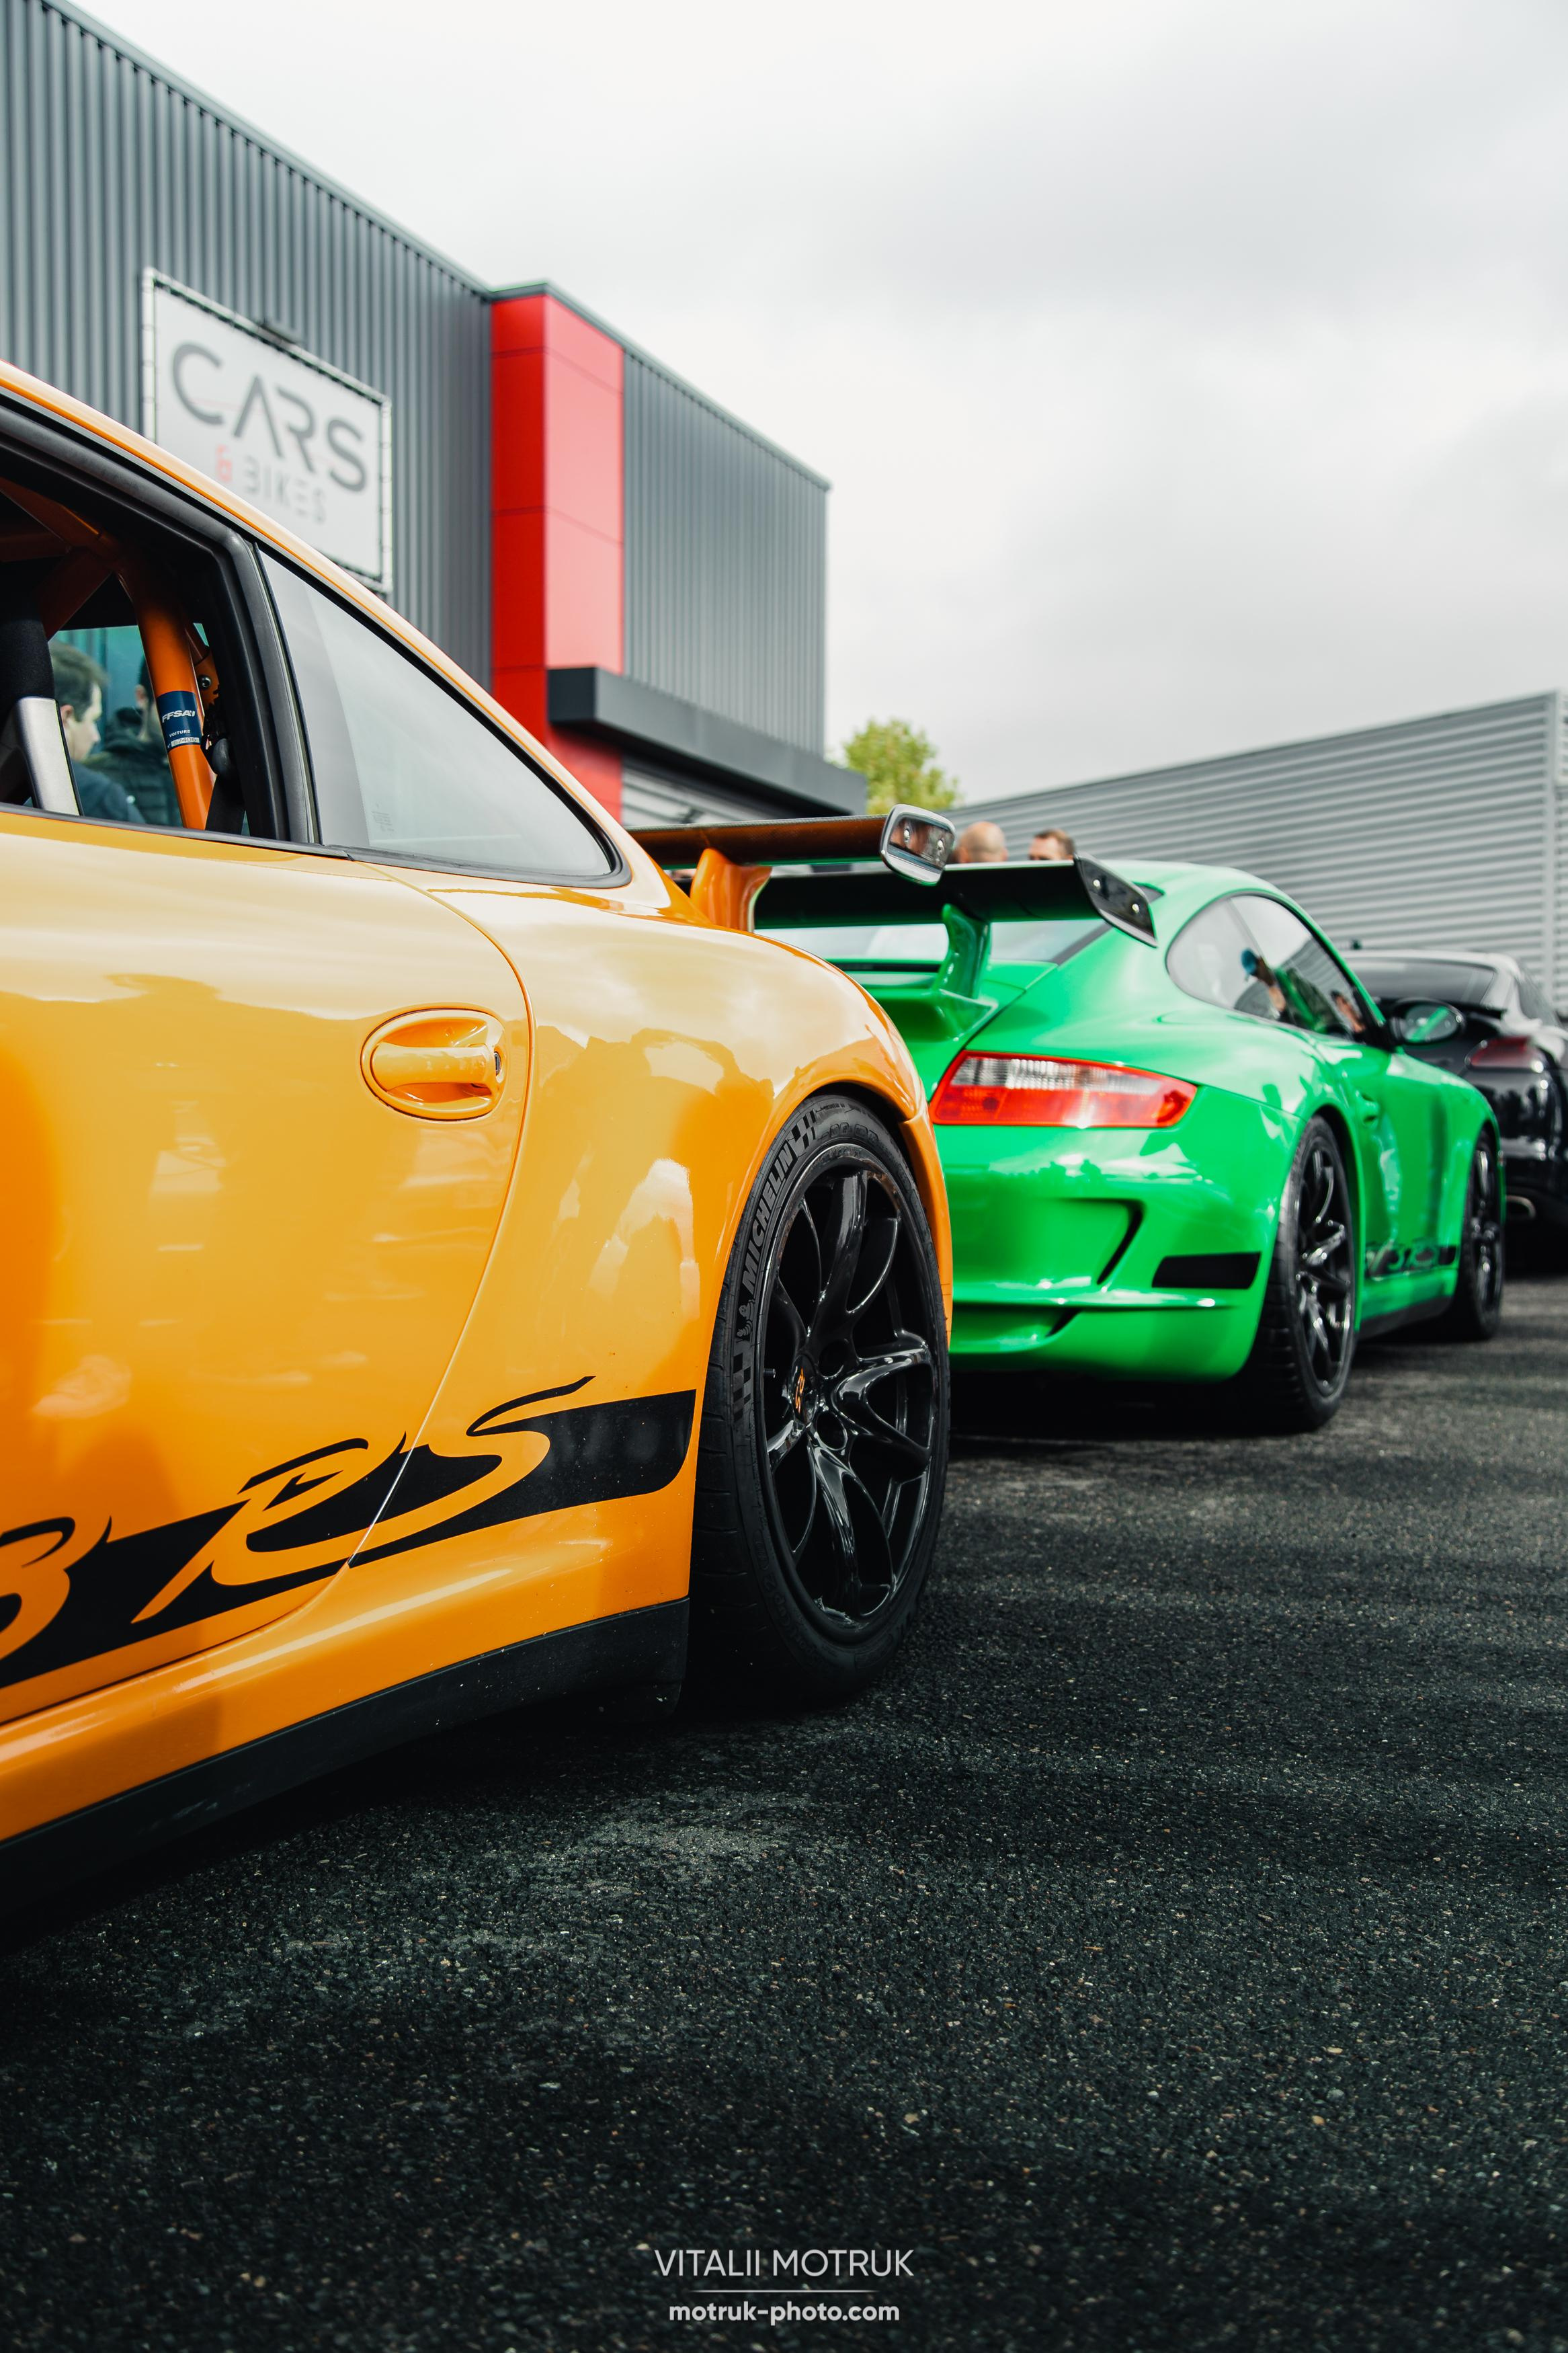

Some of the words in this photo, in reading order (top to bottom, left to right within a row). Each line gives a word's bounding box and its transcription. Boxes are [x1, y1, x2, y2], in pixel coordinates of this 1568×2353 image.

[172, 342, 367, 494] CARS
[169, 729, 190, 737] VOITURE
[742, 1142, 794, 1295] MICHELIN
